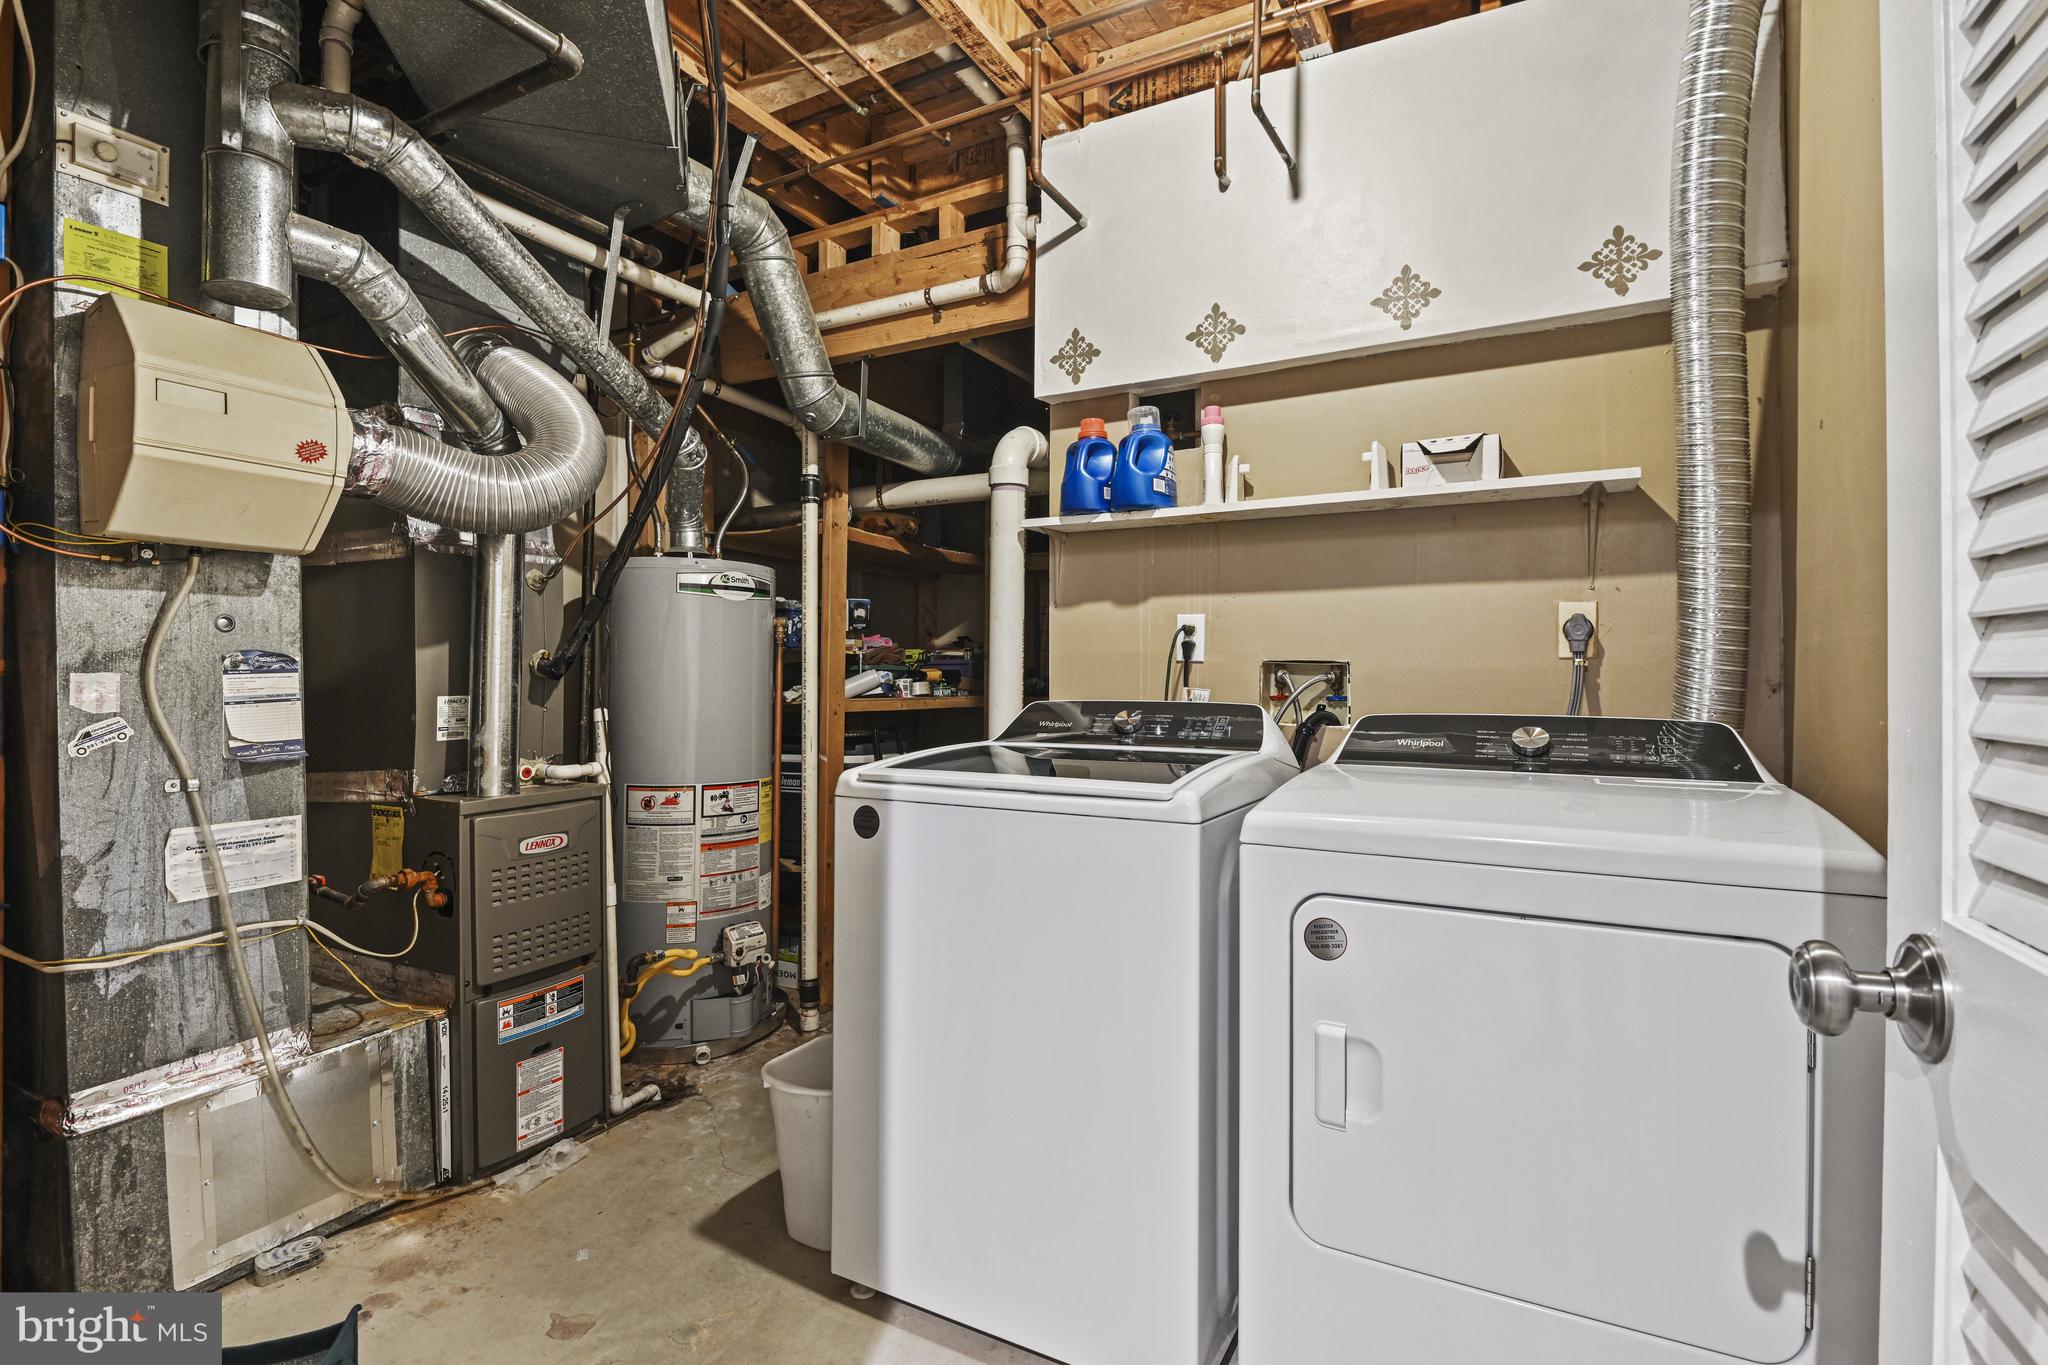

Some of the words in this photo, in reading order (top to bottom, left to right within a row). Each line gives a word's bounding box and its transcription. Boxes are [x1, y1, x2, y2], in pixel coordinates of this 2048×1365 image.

[731, 576, 750, 585] Smith
[1040, 720, 1073, 728] Whirlpool
[1397, 739, 1444, 748] Whirlpool
[525, 837, 557, 851] LENNOX
